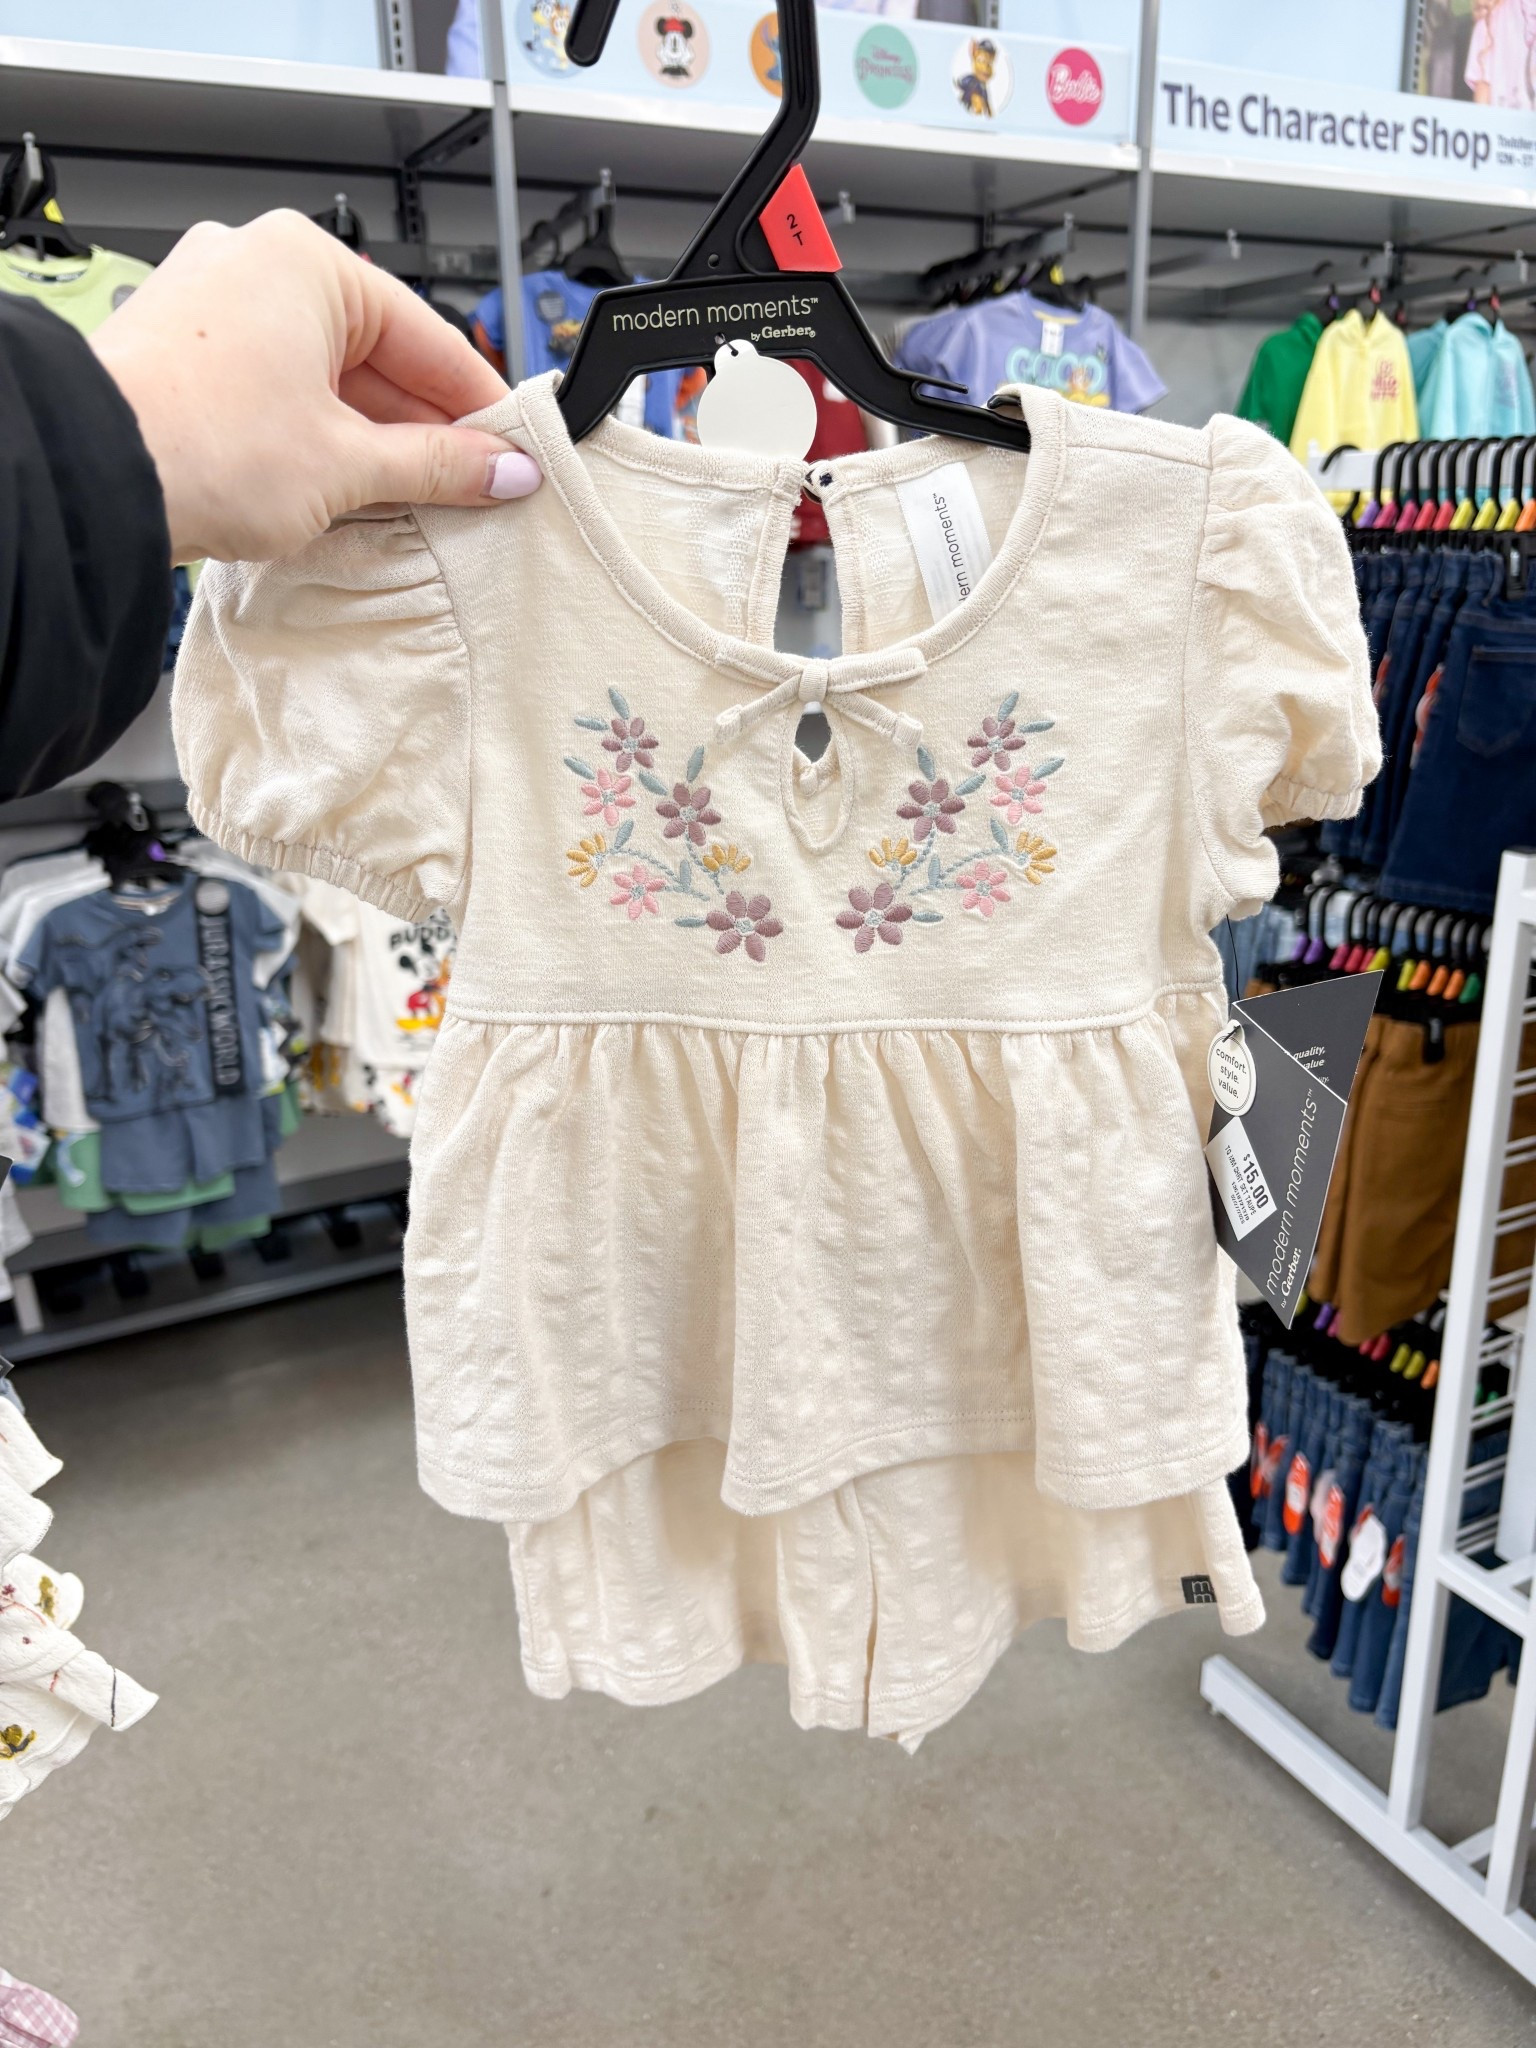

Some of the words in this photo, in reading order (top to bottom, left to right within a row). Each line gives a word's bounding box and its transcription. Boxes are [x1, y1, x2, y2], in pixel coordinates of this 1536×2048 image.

[1162, 83, 1230, 132] The
[1240, 95, 1404, 151] Character
[1411, 117, 1490, 169] Shop
[613, 304, 699, 331] modern
[751, 332, 760, 341] by
[211, 1009, 241, 1086] WORLD
[1216, 1048, 1247, 1075] comfort.
[1220, 1065, 1240, 1084] style.
[1218, 1078, 1239, 1099] value.
[1243, 1153, 1269, 1209] $15.00
[1266, 1210, 1294, 1295] modern
